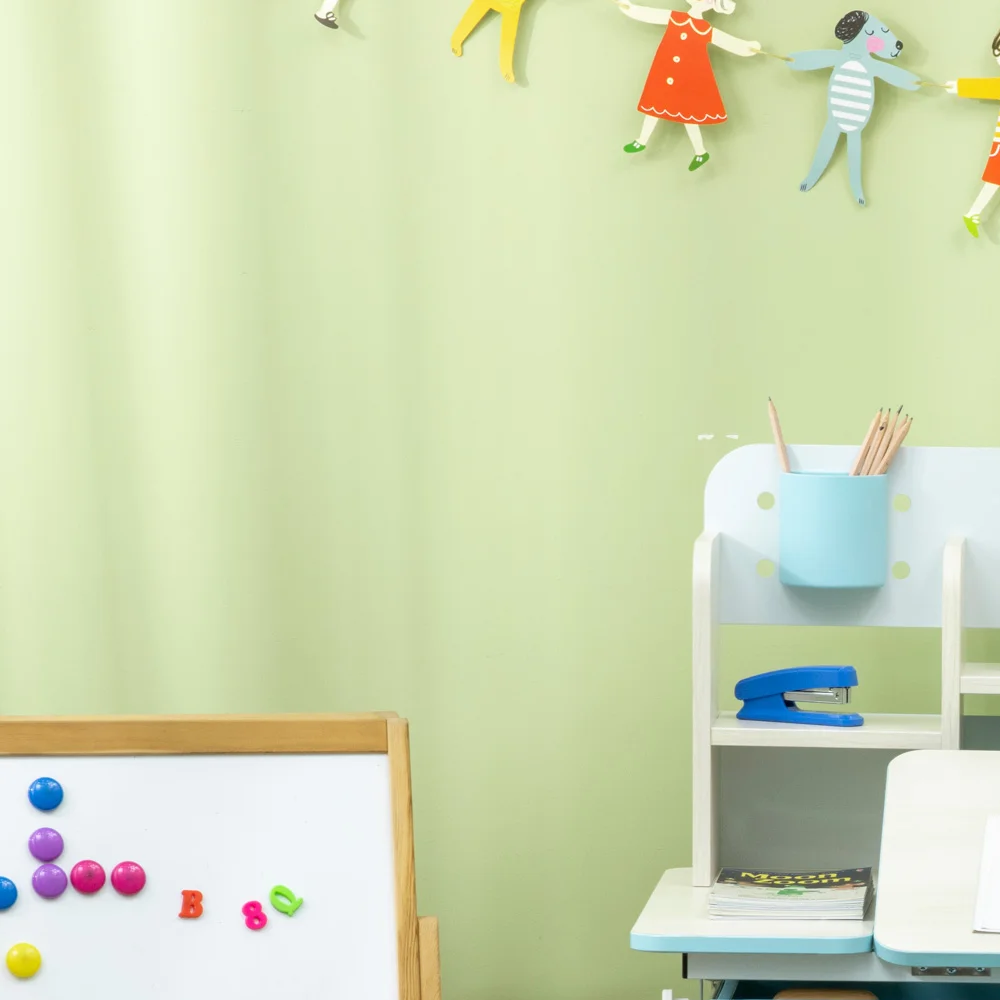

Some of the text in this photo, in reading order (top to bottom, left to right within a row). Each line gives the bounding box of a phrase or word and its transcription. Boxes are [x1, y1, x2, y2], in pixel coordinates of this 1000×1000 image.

[741, 871, 837, 880] Moon
[178, 889, 204, 919] B
[242, 900, 268, 931] 8
[269, 884, 303, 917] Q
